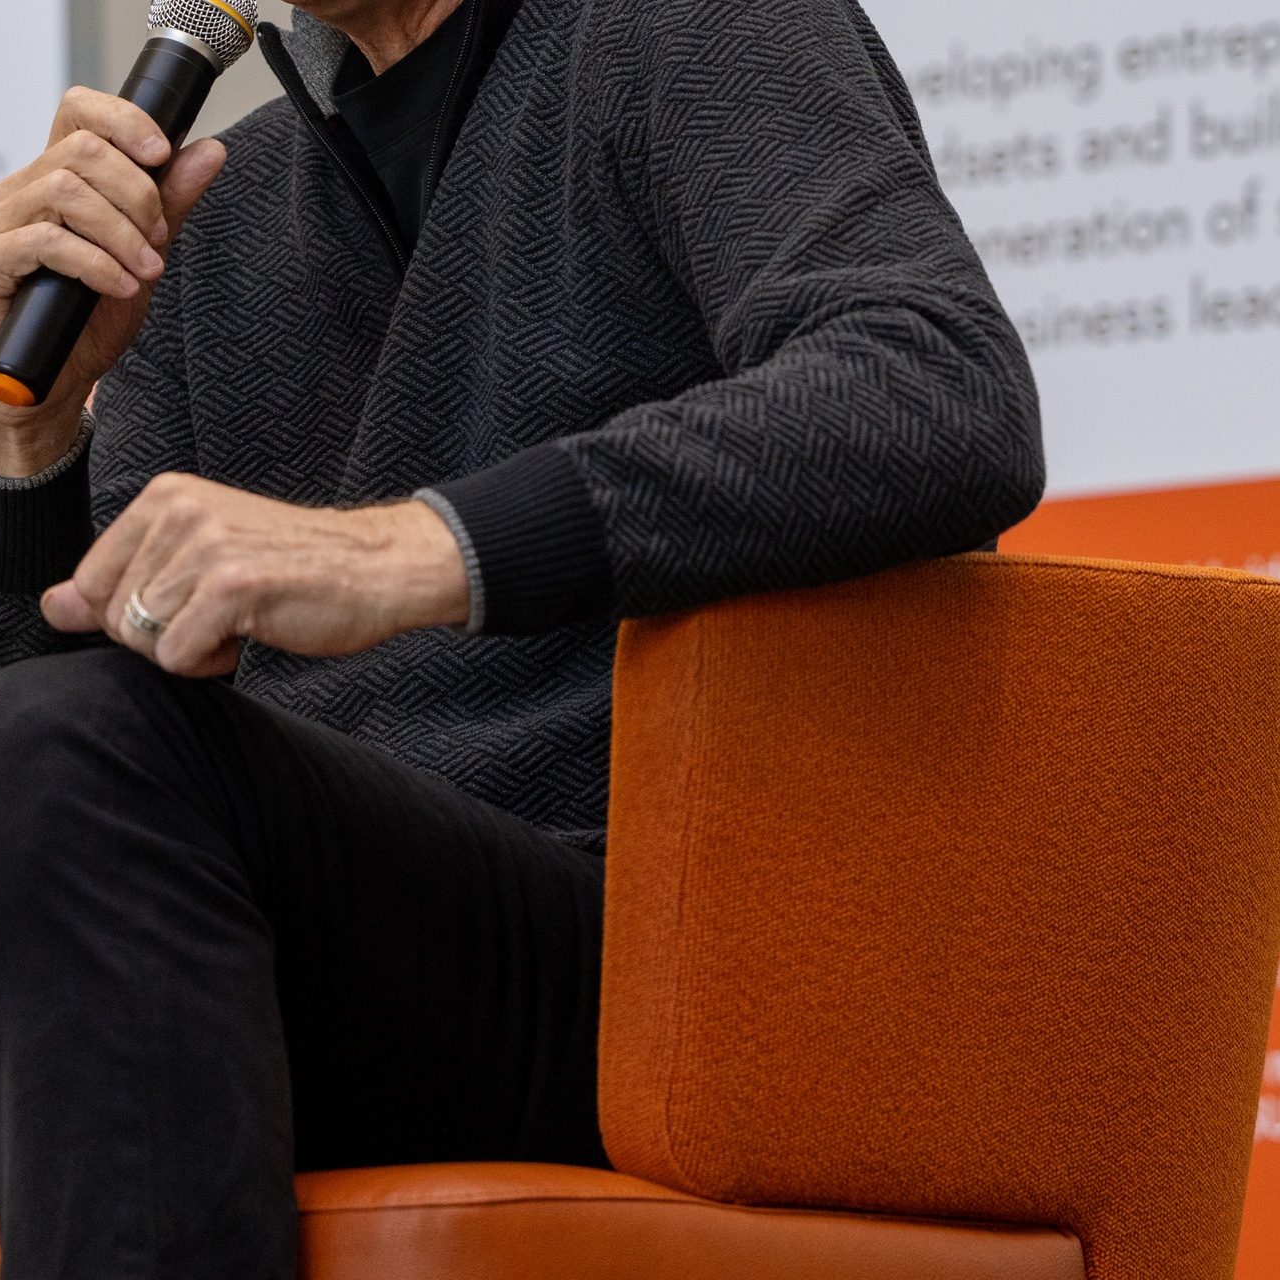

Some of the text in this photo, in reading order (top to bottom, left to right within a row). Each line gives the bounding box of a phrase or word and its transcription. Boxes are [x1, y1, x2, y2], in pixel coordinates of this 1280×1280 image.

[909, 35, 1104, 112] eloping
[936, 123, 1062, 190] dsets
[1076, 97, 1174, 175] and
[970, 195, 1193, 267] neration
[1204, 174, 1262, 246] of
[1020, 292, 1174, 353] siness
